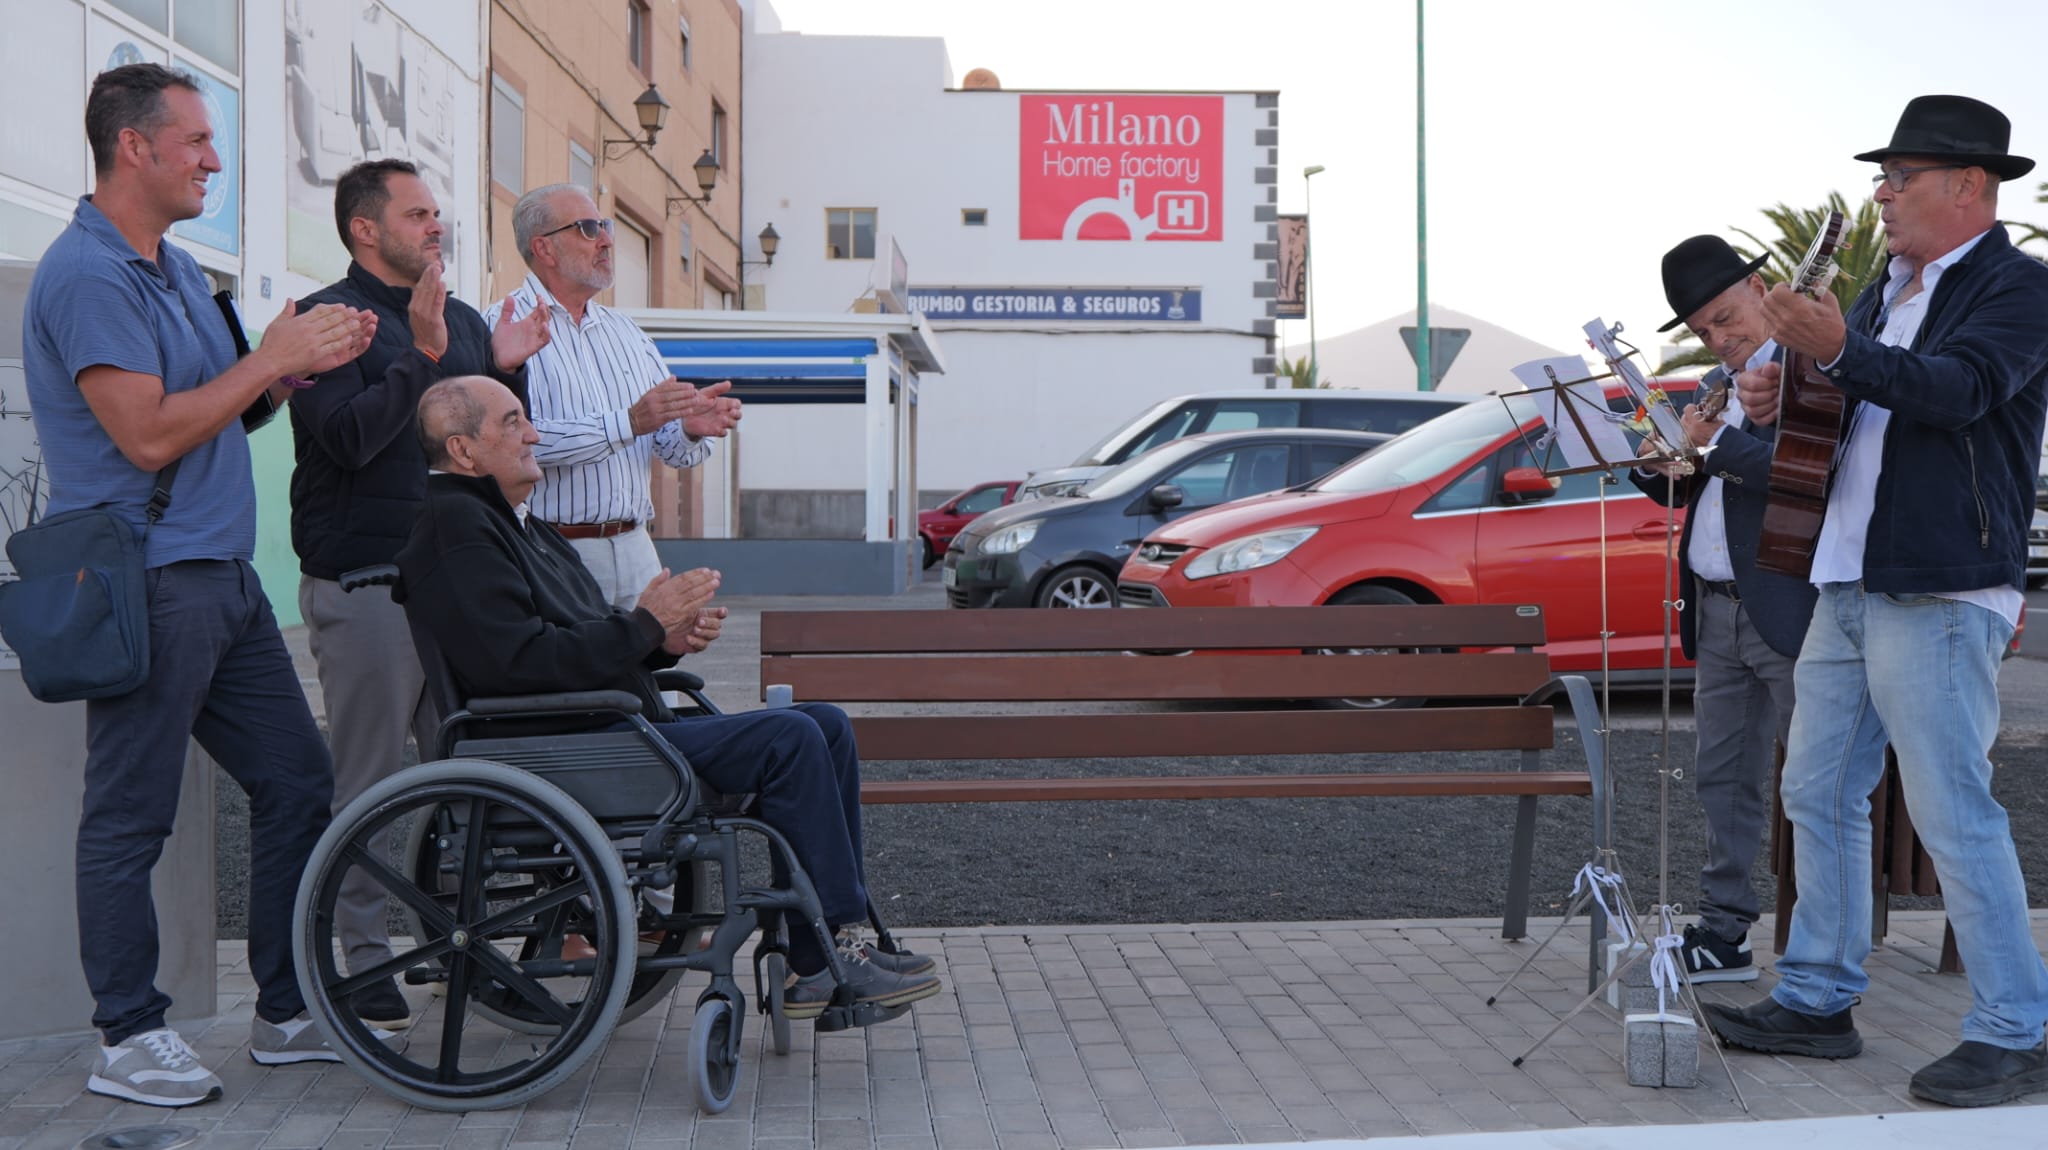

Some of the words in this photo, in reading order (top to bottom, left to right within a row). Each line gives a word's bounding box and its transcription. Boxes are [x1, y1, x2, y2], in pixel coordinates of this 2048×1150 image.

[1044, 102, 1201, 146] Milano
[1043, 150, 1111, 177] Home
[1119, 151, 1200, 184] factory
[1167, 198, 1195, 226] H
[907, 295, 966, 314] RUMBO
[972, 295, 1057, 314] GESTORIA
[1062, 296, 1077, 313] &
[1083, 296, 1161, 314] SEGUROS
